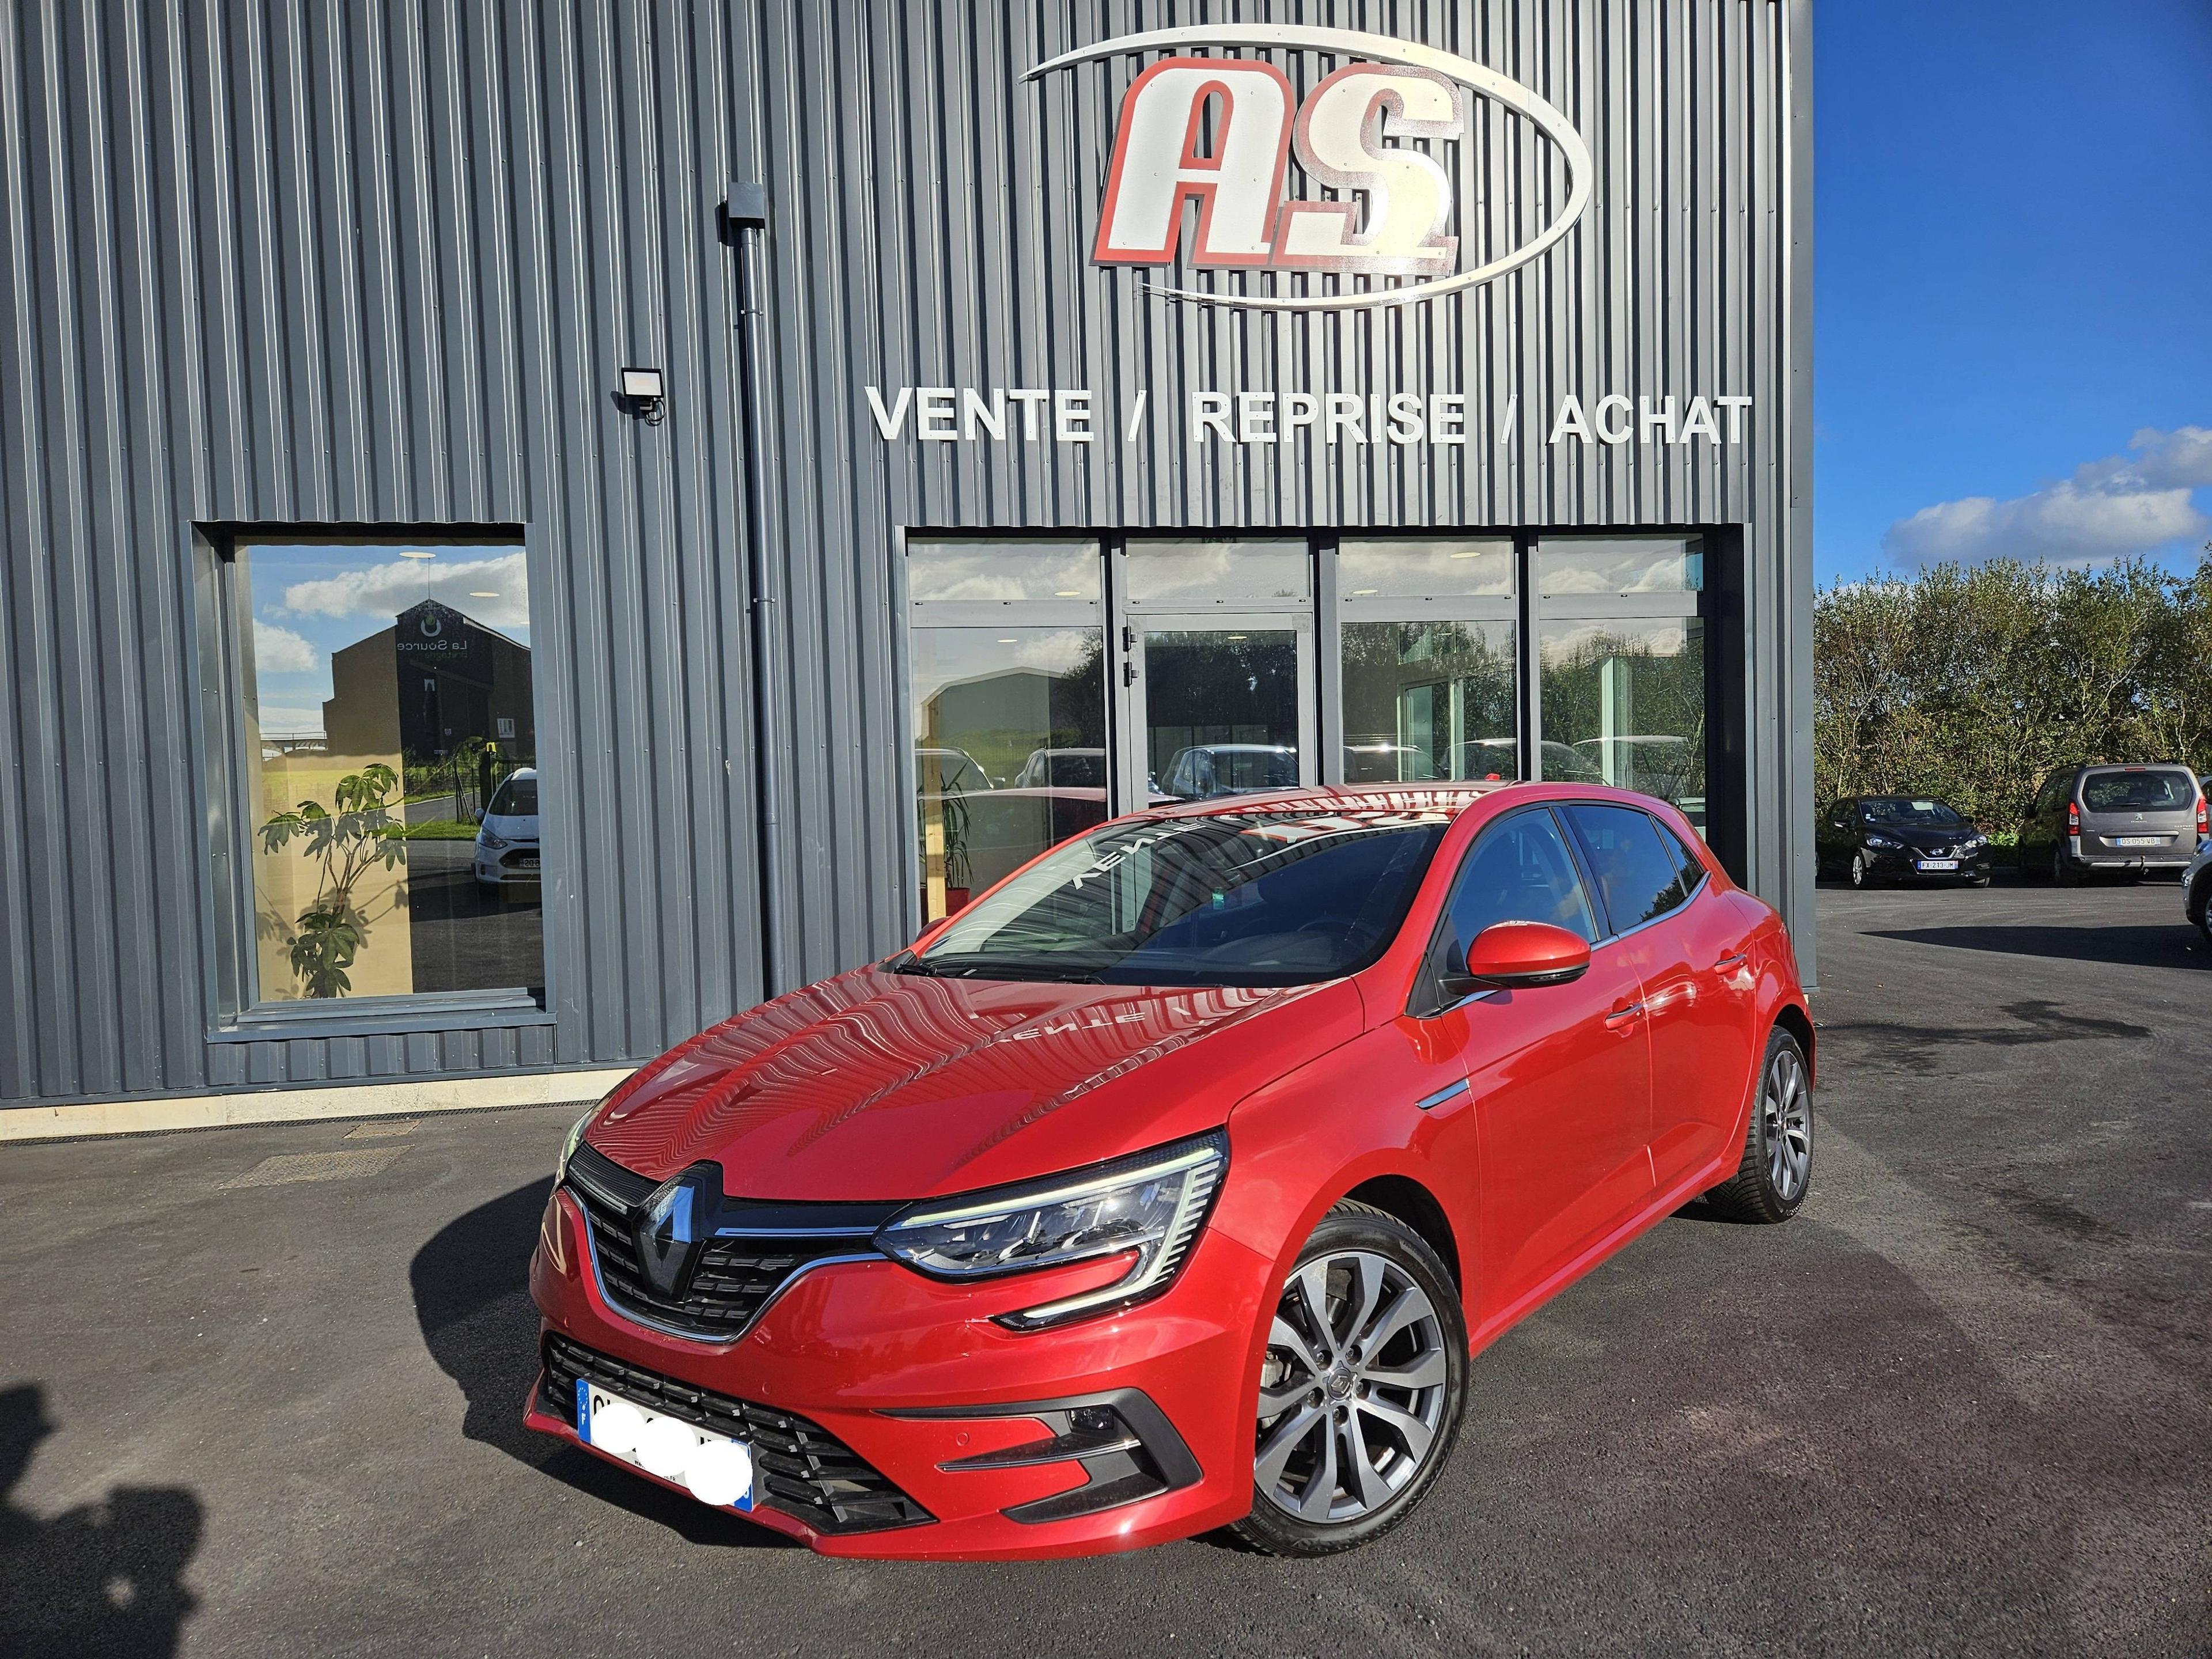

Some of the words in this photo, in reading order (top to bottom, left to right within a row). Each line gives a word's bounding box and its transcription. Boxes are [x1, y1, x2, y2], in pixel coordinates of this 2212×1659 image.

[1089, 56, 1465, 276] AS
[863, 386, 1094, 441] VENTE
[1127, 389, 1147, 442] /
[1192, 392, 1466, 444] REPRISE
[1499, 393, 1518, 444] /
[1548, 394, 1753, 444] ACHAT
